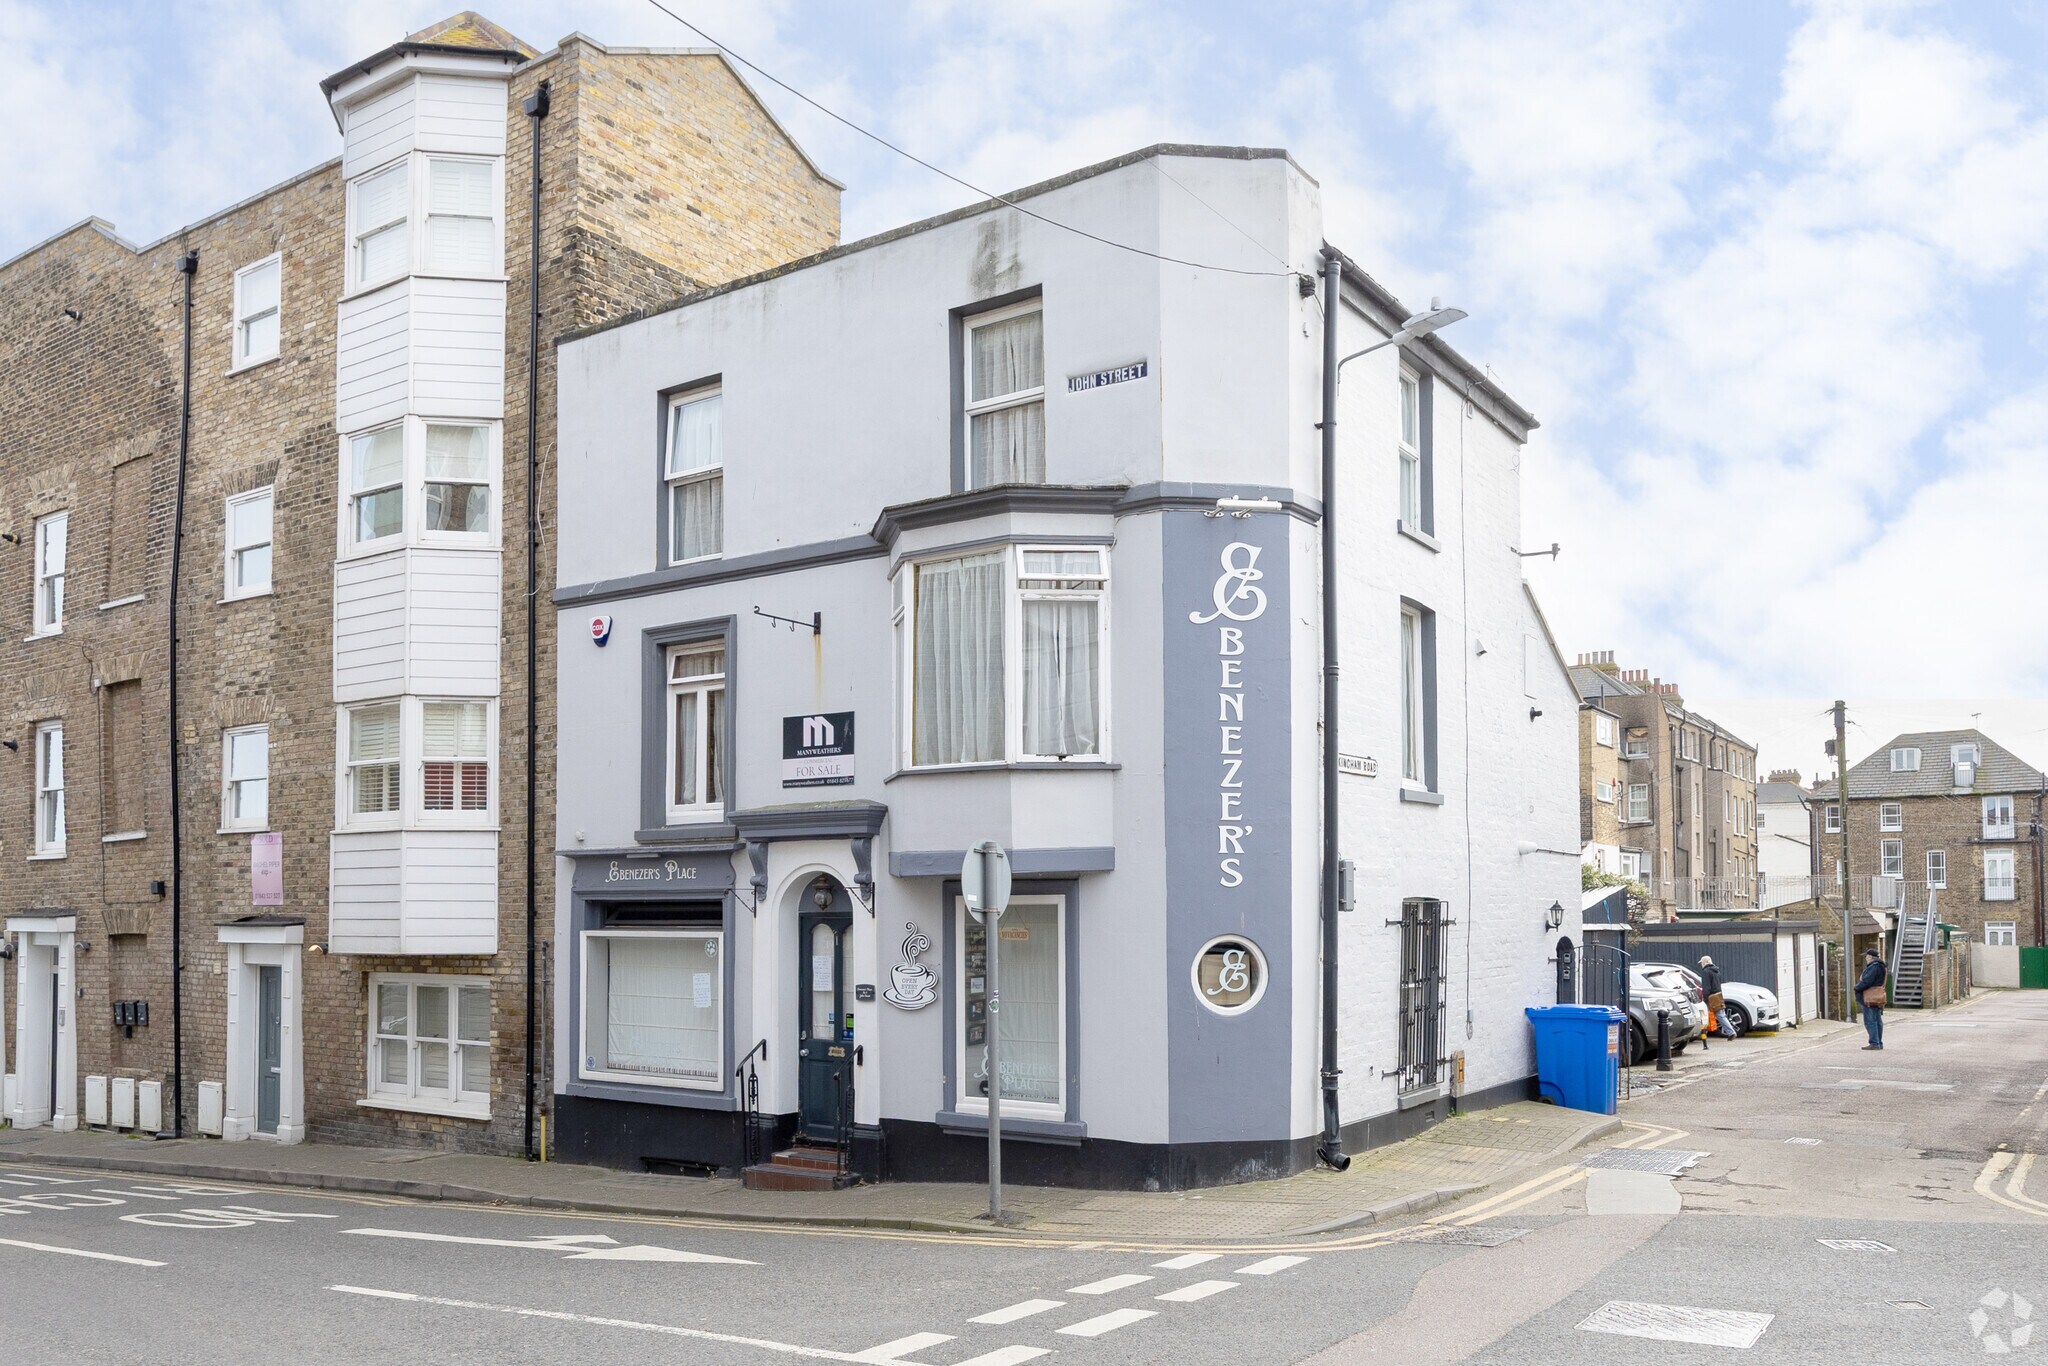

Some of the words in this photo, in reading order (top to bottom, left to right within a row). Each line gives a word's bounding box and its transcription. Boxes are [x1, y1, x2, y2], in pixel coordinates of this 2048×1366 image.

[1068, 374, 1097, 392] JOHN
[1101, 363, 1144, 386] STREET
[797, 747, 842, 756] MANYWEATHERS
[796, 766, 815, 777] FOR
[817, 764, 841, 776] SALE
[1364, 761, 1376, 772] ROAD
[605, 860, 661, 883] EBENEZER'S
[664, 859, 697, 881] PLACE
[1001, 1073, 1041, 1092] PLACE
